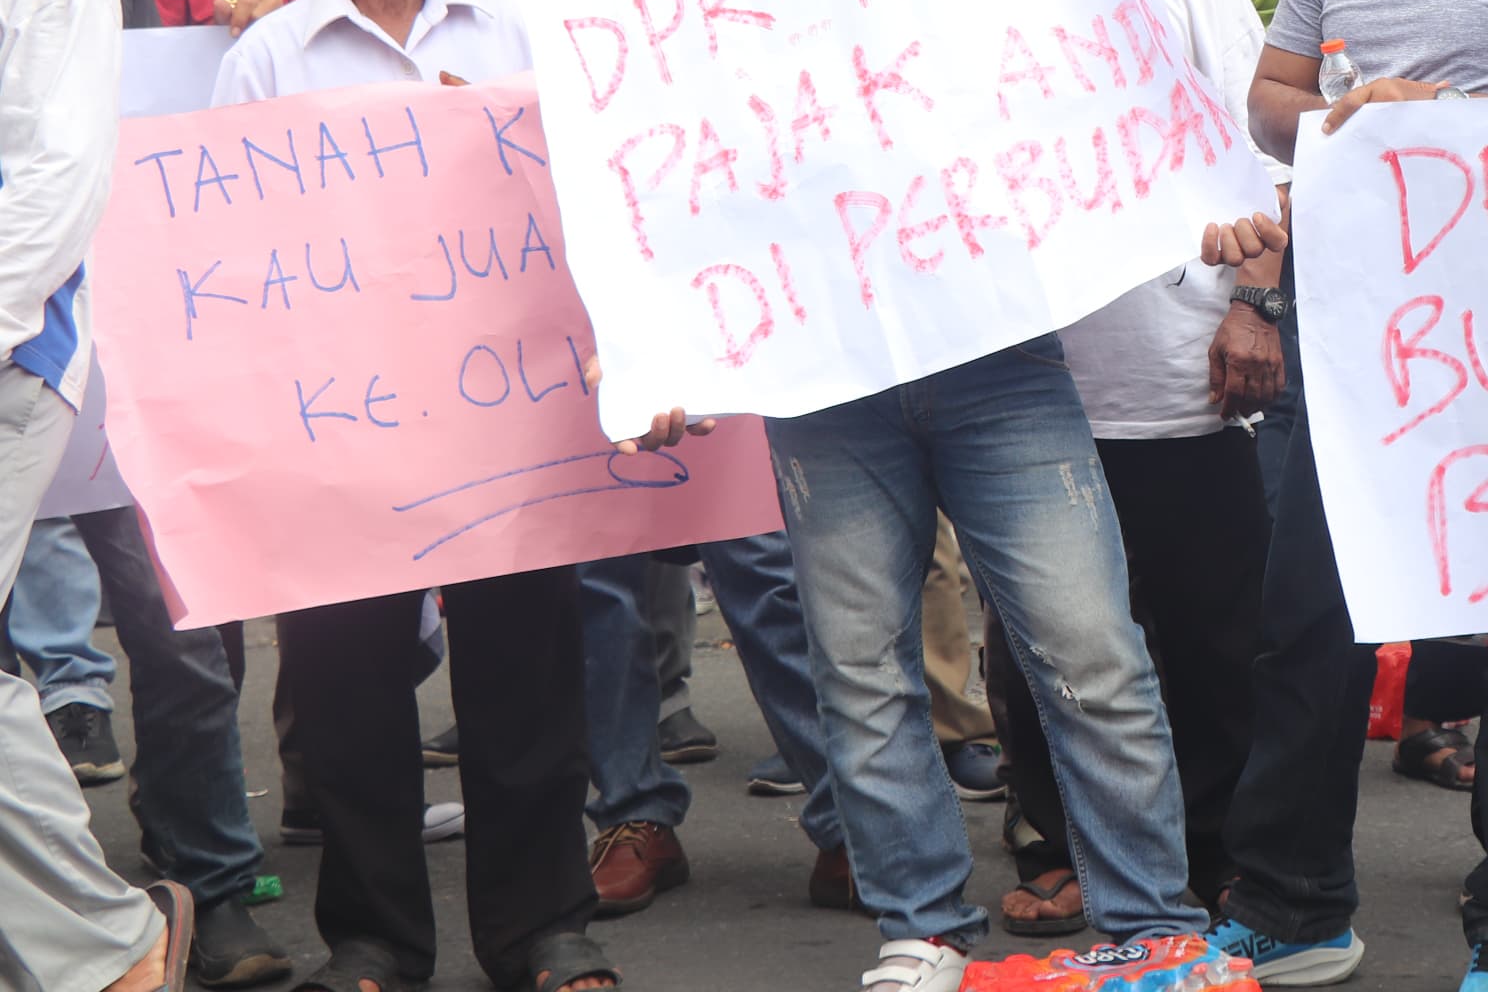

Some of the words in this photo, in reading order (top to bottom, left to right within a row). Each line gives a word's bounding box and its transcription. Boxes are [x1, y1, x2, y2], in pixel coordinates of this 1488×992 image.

[134, 106, 432, 218] TANAH
[606, 39, 934, 262] PAJAK
[177, 237, 362, 340] KAU
[410, 212, 557, 302] JUA
[688, 242, 807, 369] DI
